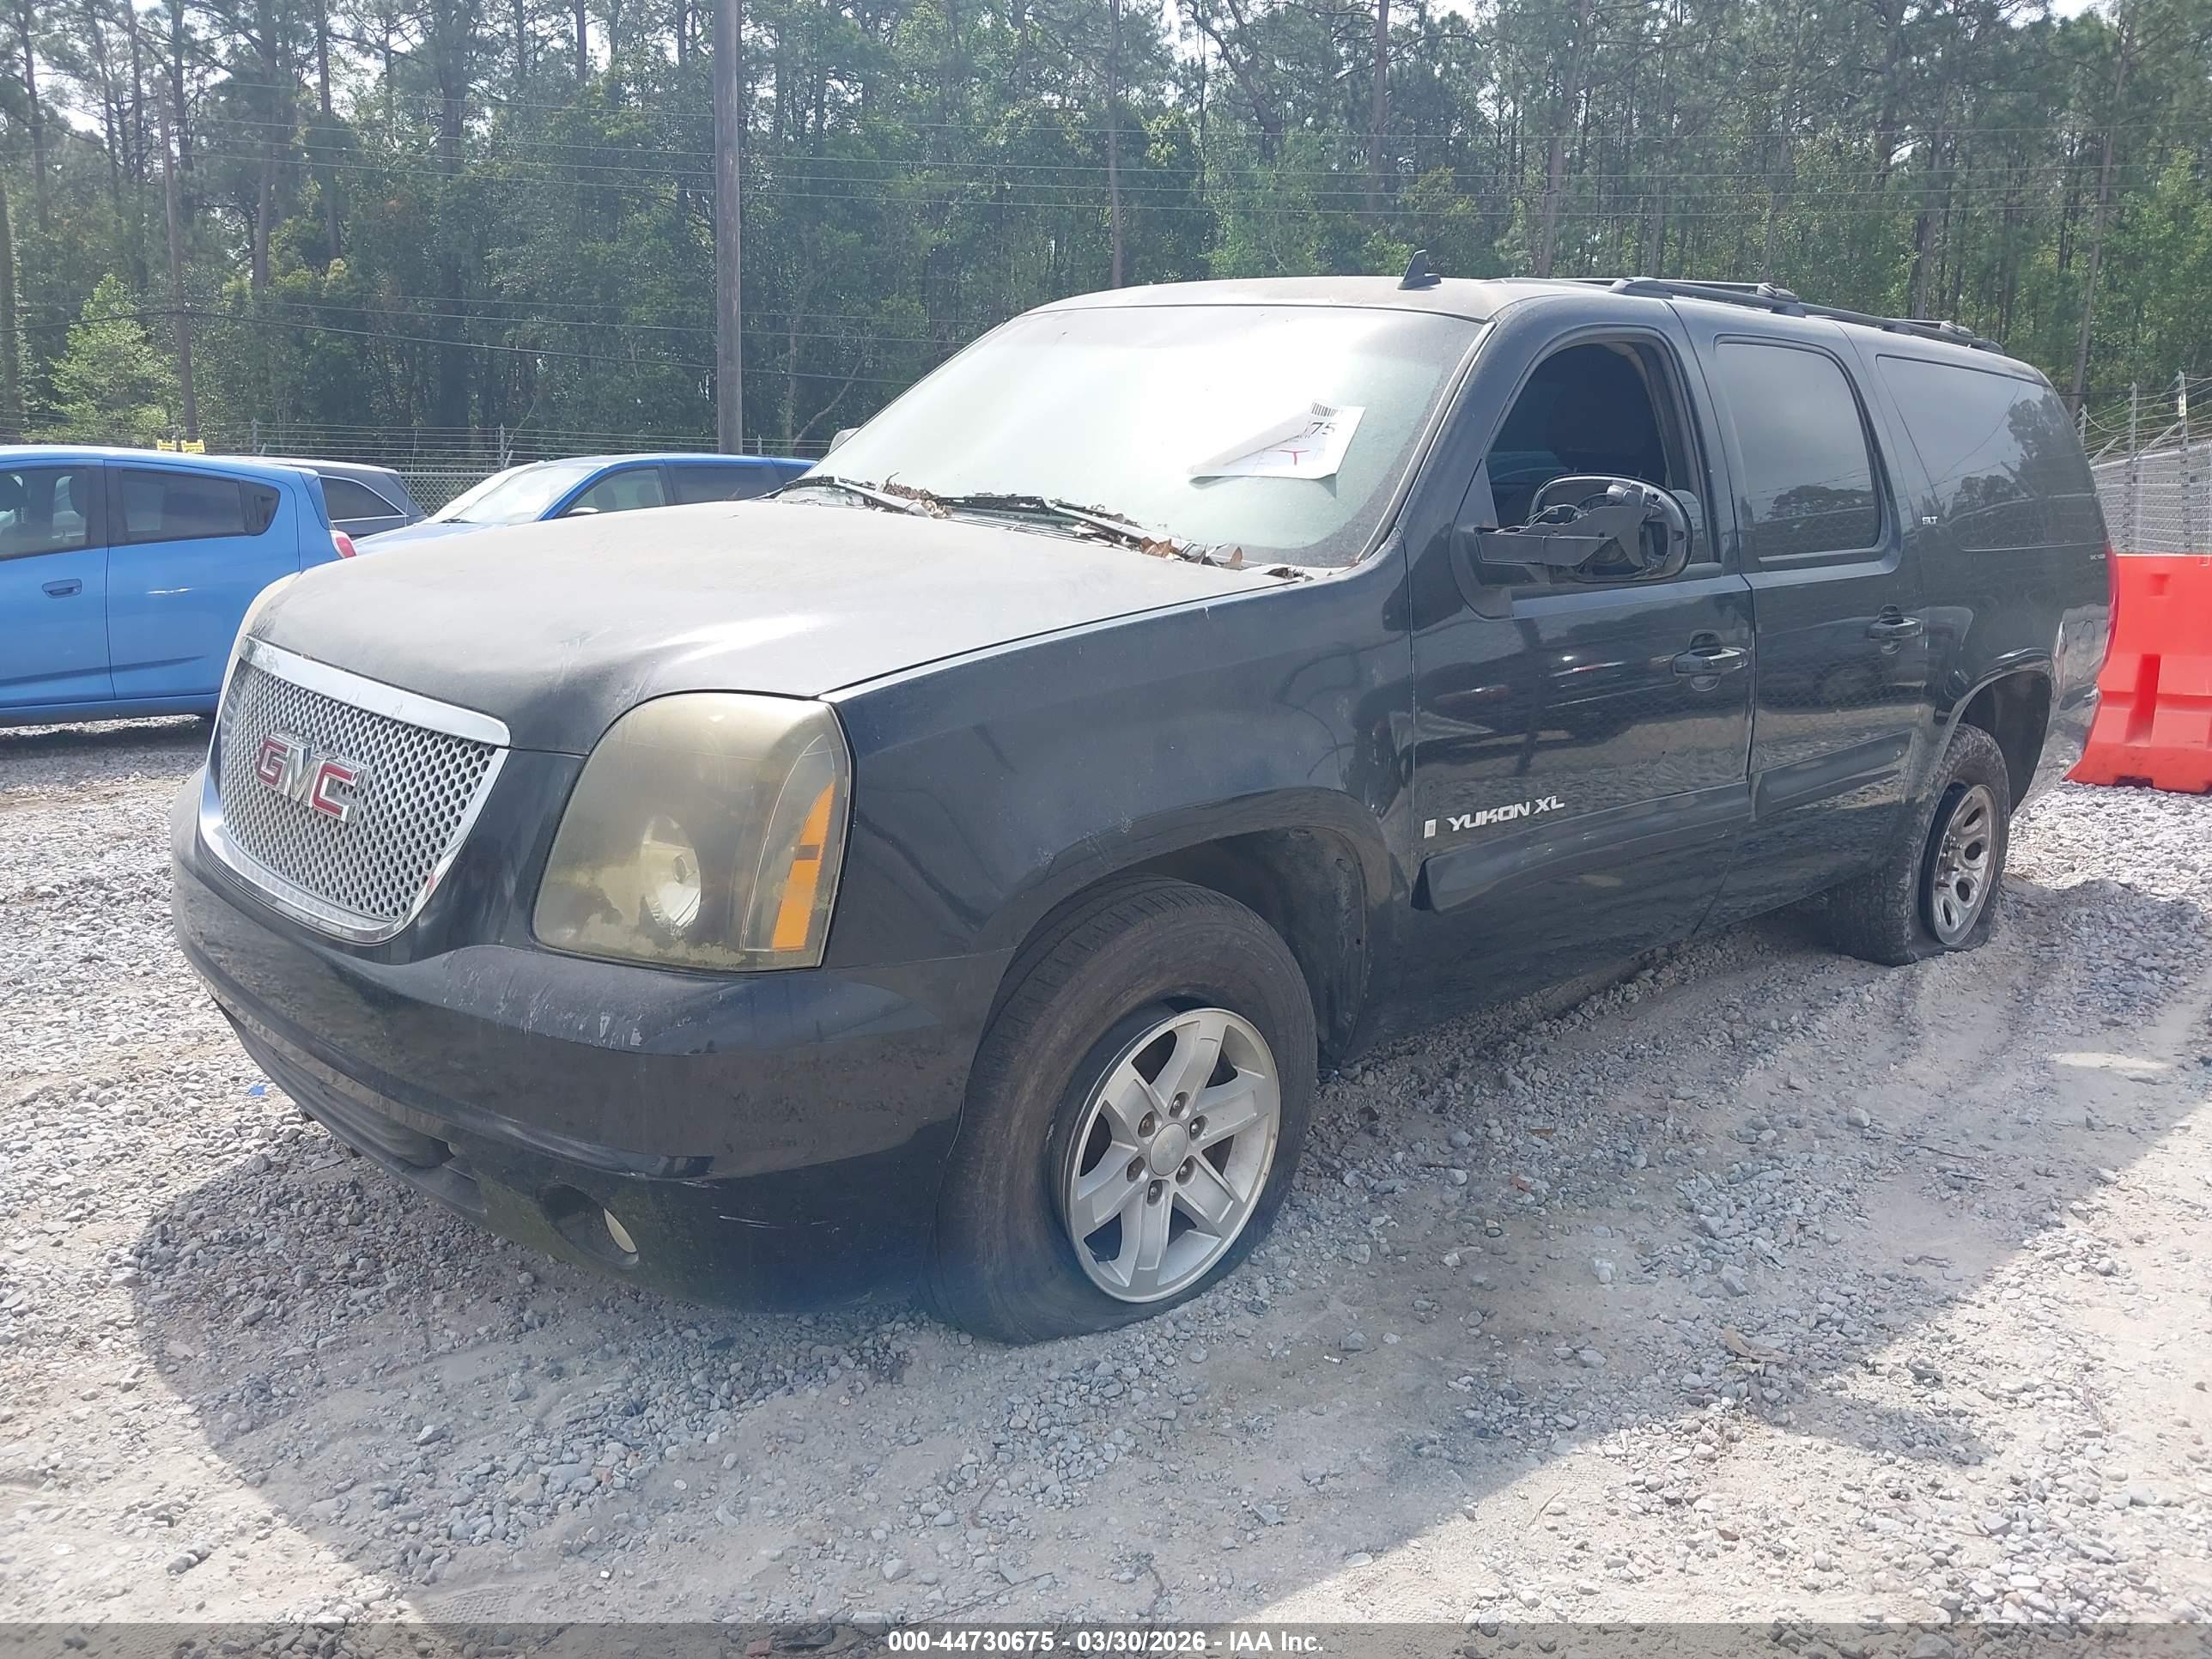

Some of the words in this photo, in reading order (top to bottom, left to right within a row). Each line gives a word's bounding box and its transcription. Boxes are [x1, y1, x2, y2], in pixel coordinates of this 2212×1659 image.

[1305, 421, 1339, 436] 75
[255, 732, 363, 823] GMC
[1446, 801, 1530, 831] YUKON
[1533, 795, 1565, 815] XL
